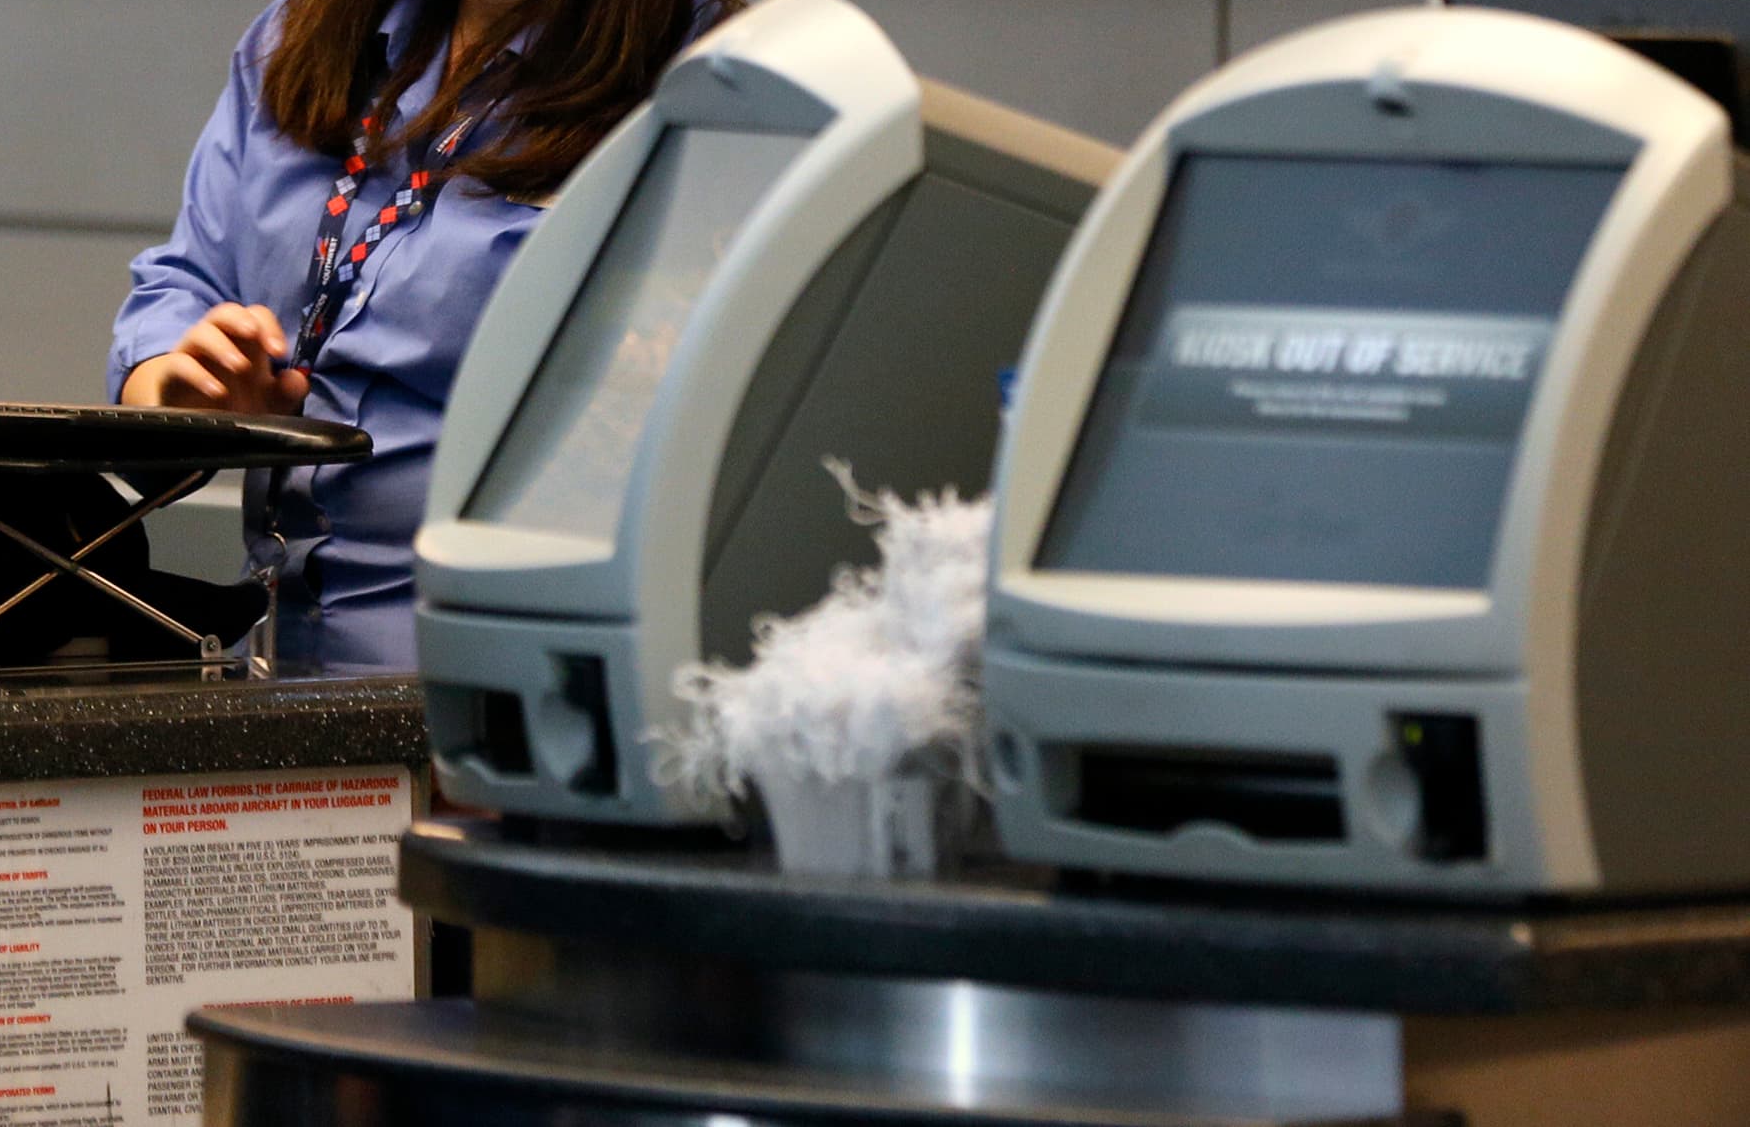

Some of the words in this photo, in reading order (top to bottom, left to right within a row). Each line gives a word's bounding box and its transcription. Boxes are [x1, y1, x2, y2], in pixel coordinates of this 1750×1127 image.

[1274, 334, 1346, 372] OUT
[1344, 335, 1396, 374] OF
[143, 788, 184, 801] FEDERAL
[188, 787, 208, 798] LAW
[211, 785, 252, 797] FORBIDS
[256, 783, 272, 795] THE
[276, 781, 323, 794] CARRIAGE
[326, 780, 338, 791] OF
[341, 777, 398, 790] HAZARDOUS
[143, 804, 196, 818] MATERIALS
[200, 802, 238, 814] ABOARD
[241, 799, 287, 812] AIRCRAFT
[291, 798, 300, 809] IN
[303, 797, 328, 809] YOUR
[332, 794, 374, 807] LUGGAGE
[378, 793, 391, 805] OR
[143, 822, 156, 834] ON
[160, 821, 184, 833] YOUR
[188, 818, 228, 832] PERSON.
[143, 847, 148, 856] A
[150, 844, 187, 856] VIOLATION
[190, 843, 204, 854] CAN
[207, 842, 235, 853] RESULT
[237, 841, 244, 851] IN
[246, 840, 261, 851] FIVE
[304, 835, 360, 848] IMPRISONMENT
[362, 834, 376, 844] AND
[144, 857, 159, 867] TIES
[161, 857, 169, 866] OF
[207, 854, 217, 864] OR
[219, 853, 239, 863] MORE
[144, 866, 188, 878] HAZARDOUS
[190, 863, 232, 875] MATERIALS
[314, 856, 363, 868] COMPRESSED
[222, 874, 236, 884] AND
[144, 887, 192, 899] RADIOACTIVE
[194, 885, 235, 896] MATERIALS
[237, 884, 252, 894] AND
[255, 882, 284, 893] LITHIUM
[217, 895, 248, 906] LIGHTER
[326, 890, 344, 900] TEAR
[281, 901, 333, 913] UNPROTECTED
[335, 899, 373, 910] BATTERIES
[375, 898, 386, 908] OR
[170, 918, 200, 929] LITHIUM
[202, 916, 240, 927] BATTERIES
[243, 916, 251, 925] IN
[253, 914, 286, 925] CHECKED
[145, 931, 168, 941] THERE
[170, 930, 184, 940] ARE
[186, 929, 216, 939] SPECIAL
[219, 926, 262, 938] EXCEPTIONS
[265, 925, 279, 935] FOR
[282, 924, 305, 934] SMALL
[308, 922, 350, 933] QUANTITIES
[368, 920, 376, 930] TO
[0, 944, 7, 953] OF
[145, 942, 175, 952] OUNCES
[204, 940, 213, 949] OF
[215, 937, 254, 949] MEDICINAL
[257, 936, 272, 946] AND
[275, 935, 299, 945] TOILET
[302, 933, 335, 944] ARTICLES
[337, 931, 369, 942] CARRIED
[371, 931, 379, 940] IN
[381, 930, 400, 940] YOUR
[181, 951, 197, 961] AND
[199, 950, 229, 960] CERTAIN
[232, 948, 265, 959] SMOKING
[268, 946, 309, 957] MATERIALS
[311, 944, 342, 954] CARRIED
[344, 943, 354, 953] ON
[356, 942, 376, 952] YOUR
[181, 962, 195, 972] FOR
[198, 960, 231, 971] FURTHER
[233, 958, 282, 969] INFORMATION
[285, 956, 317, 967] CONTACT
[320, 955, 341, 965] YOUR
[343, 953, 369, 963] AIRLINE
[7, 1016, 14, 1024] OF
[147, 1032, 173, 1043] UNITED
[147, 1044, 168, 1054] ARMS
[171, 1044, 178, 1053] IN
[147, 1057, 168, 1066] ARMS
[171, 1055, 191, 1065] MUST
[147, 1068, 188, 1079] CONTAINER
[147, 1080, 190, 1091] PASSENGER
